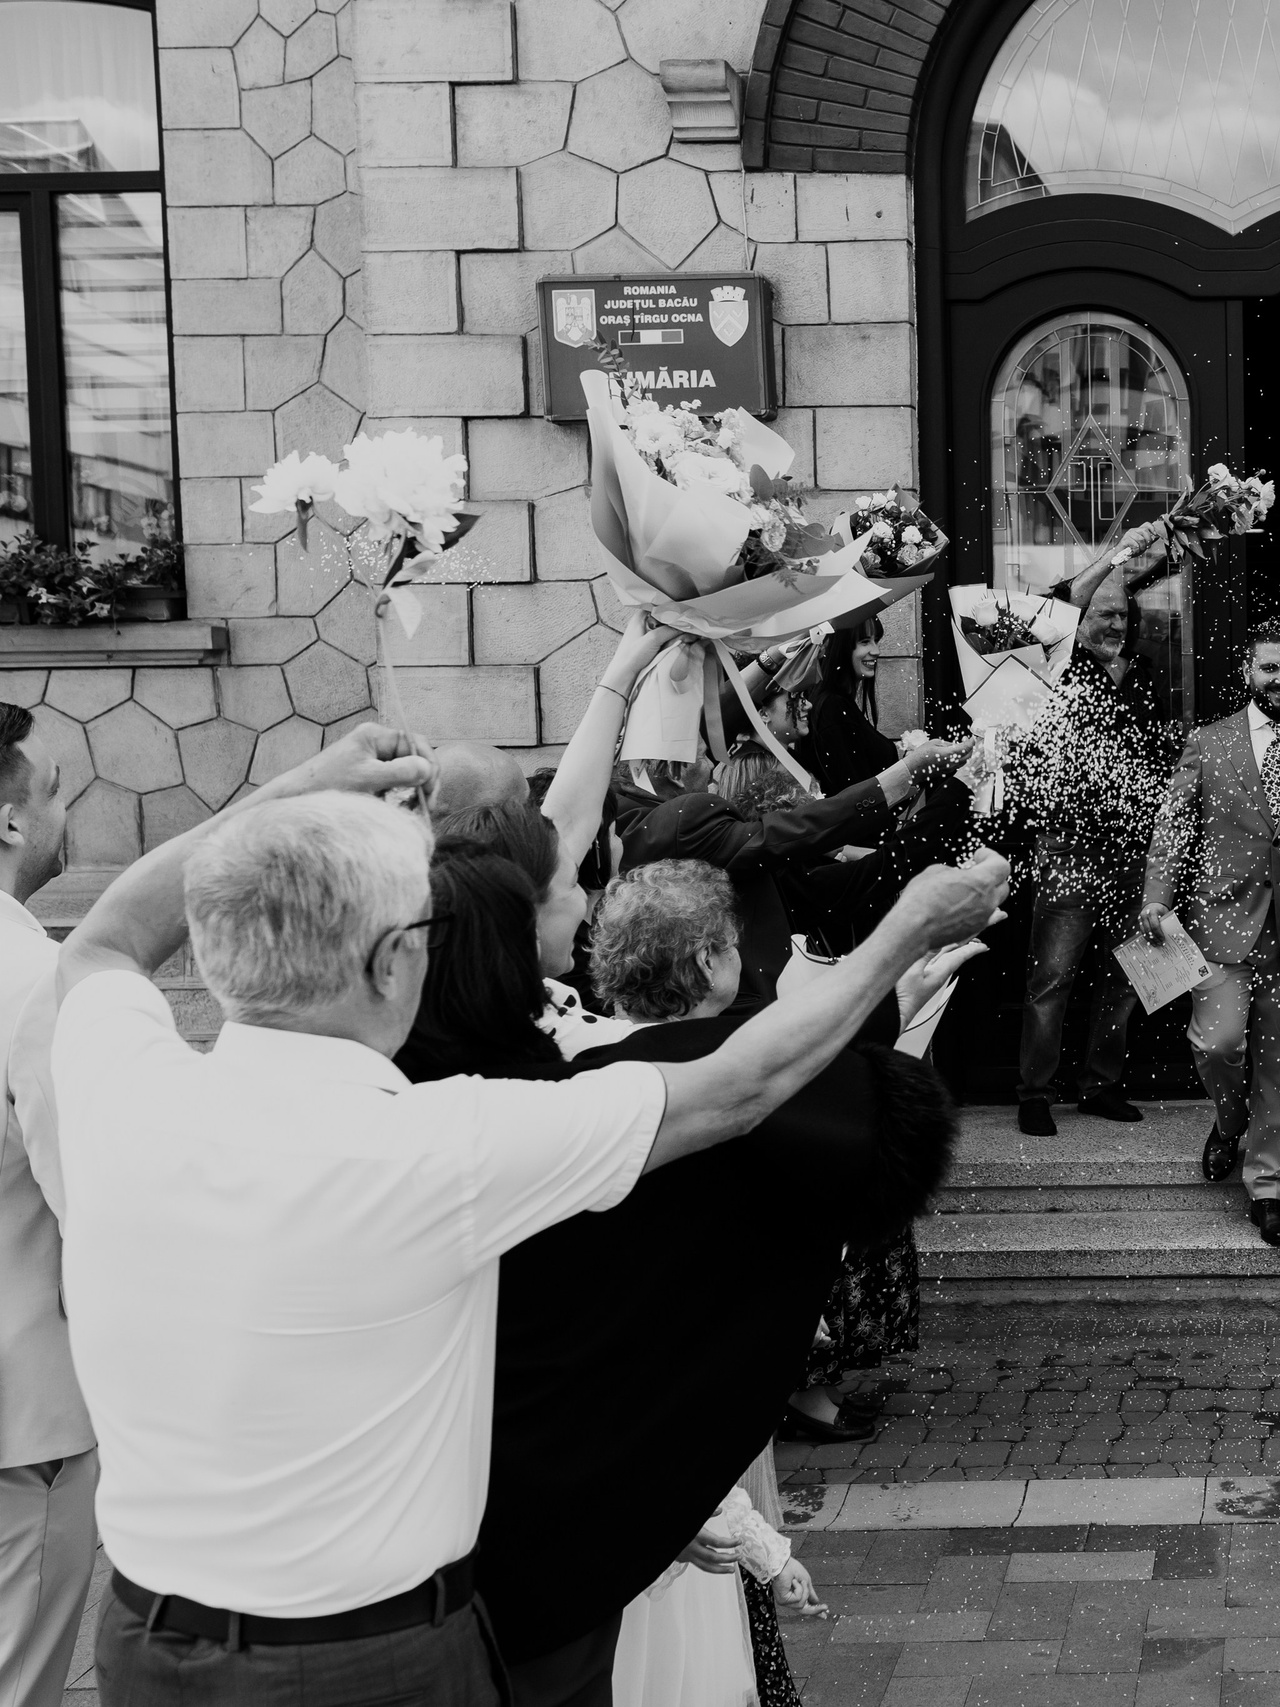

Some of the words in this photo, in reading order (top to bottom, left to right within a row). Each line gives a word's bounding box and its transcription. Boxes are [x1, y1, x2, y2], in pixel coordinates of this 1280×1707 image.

[623, 285, 677, 296] ROMANIA
[658, 296, 698, 308] BACĂU
[633, 312, 669, 324] TÎRGU
[670, 313, 704, 323] OCNA
[608, 366, 717, 389] IMĂRIA
